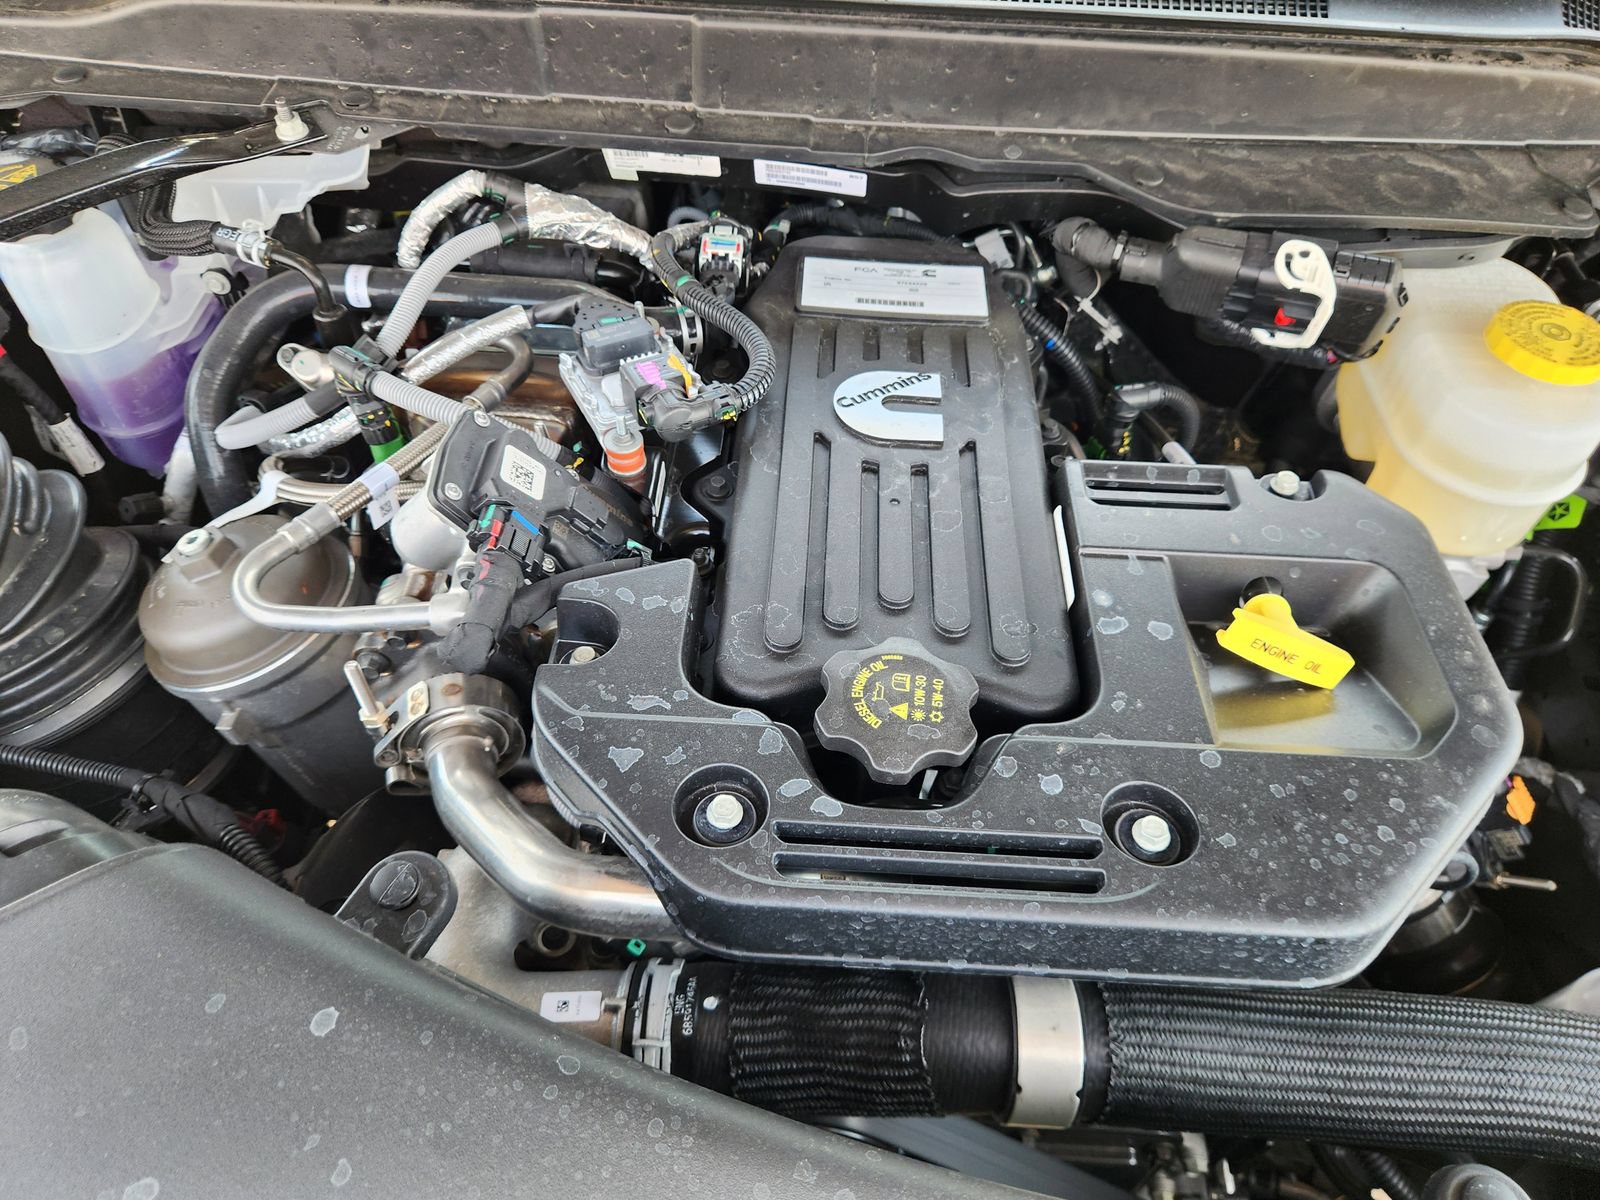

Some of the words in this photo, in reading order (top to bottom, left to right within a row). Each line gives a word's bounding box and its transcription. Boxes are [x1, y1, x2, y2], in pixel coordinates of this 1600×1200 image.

[216, 228, 239, 241] EGR
[836, 372, 932, 408] Cummins
[870, 660, 889, 672] OIL
[1250, 638, 1299, 665] ENGINE
[1304, 660, 1322, 675] OIL
[851, 667, 874, 698] ENGINE
[914, 675, 927, 706] 10W-30
[932, 678, 944, 708] 5W-40
[853, 698, 883, 729] DIESEL
[674, 994, 686, 1015] ENG
